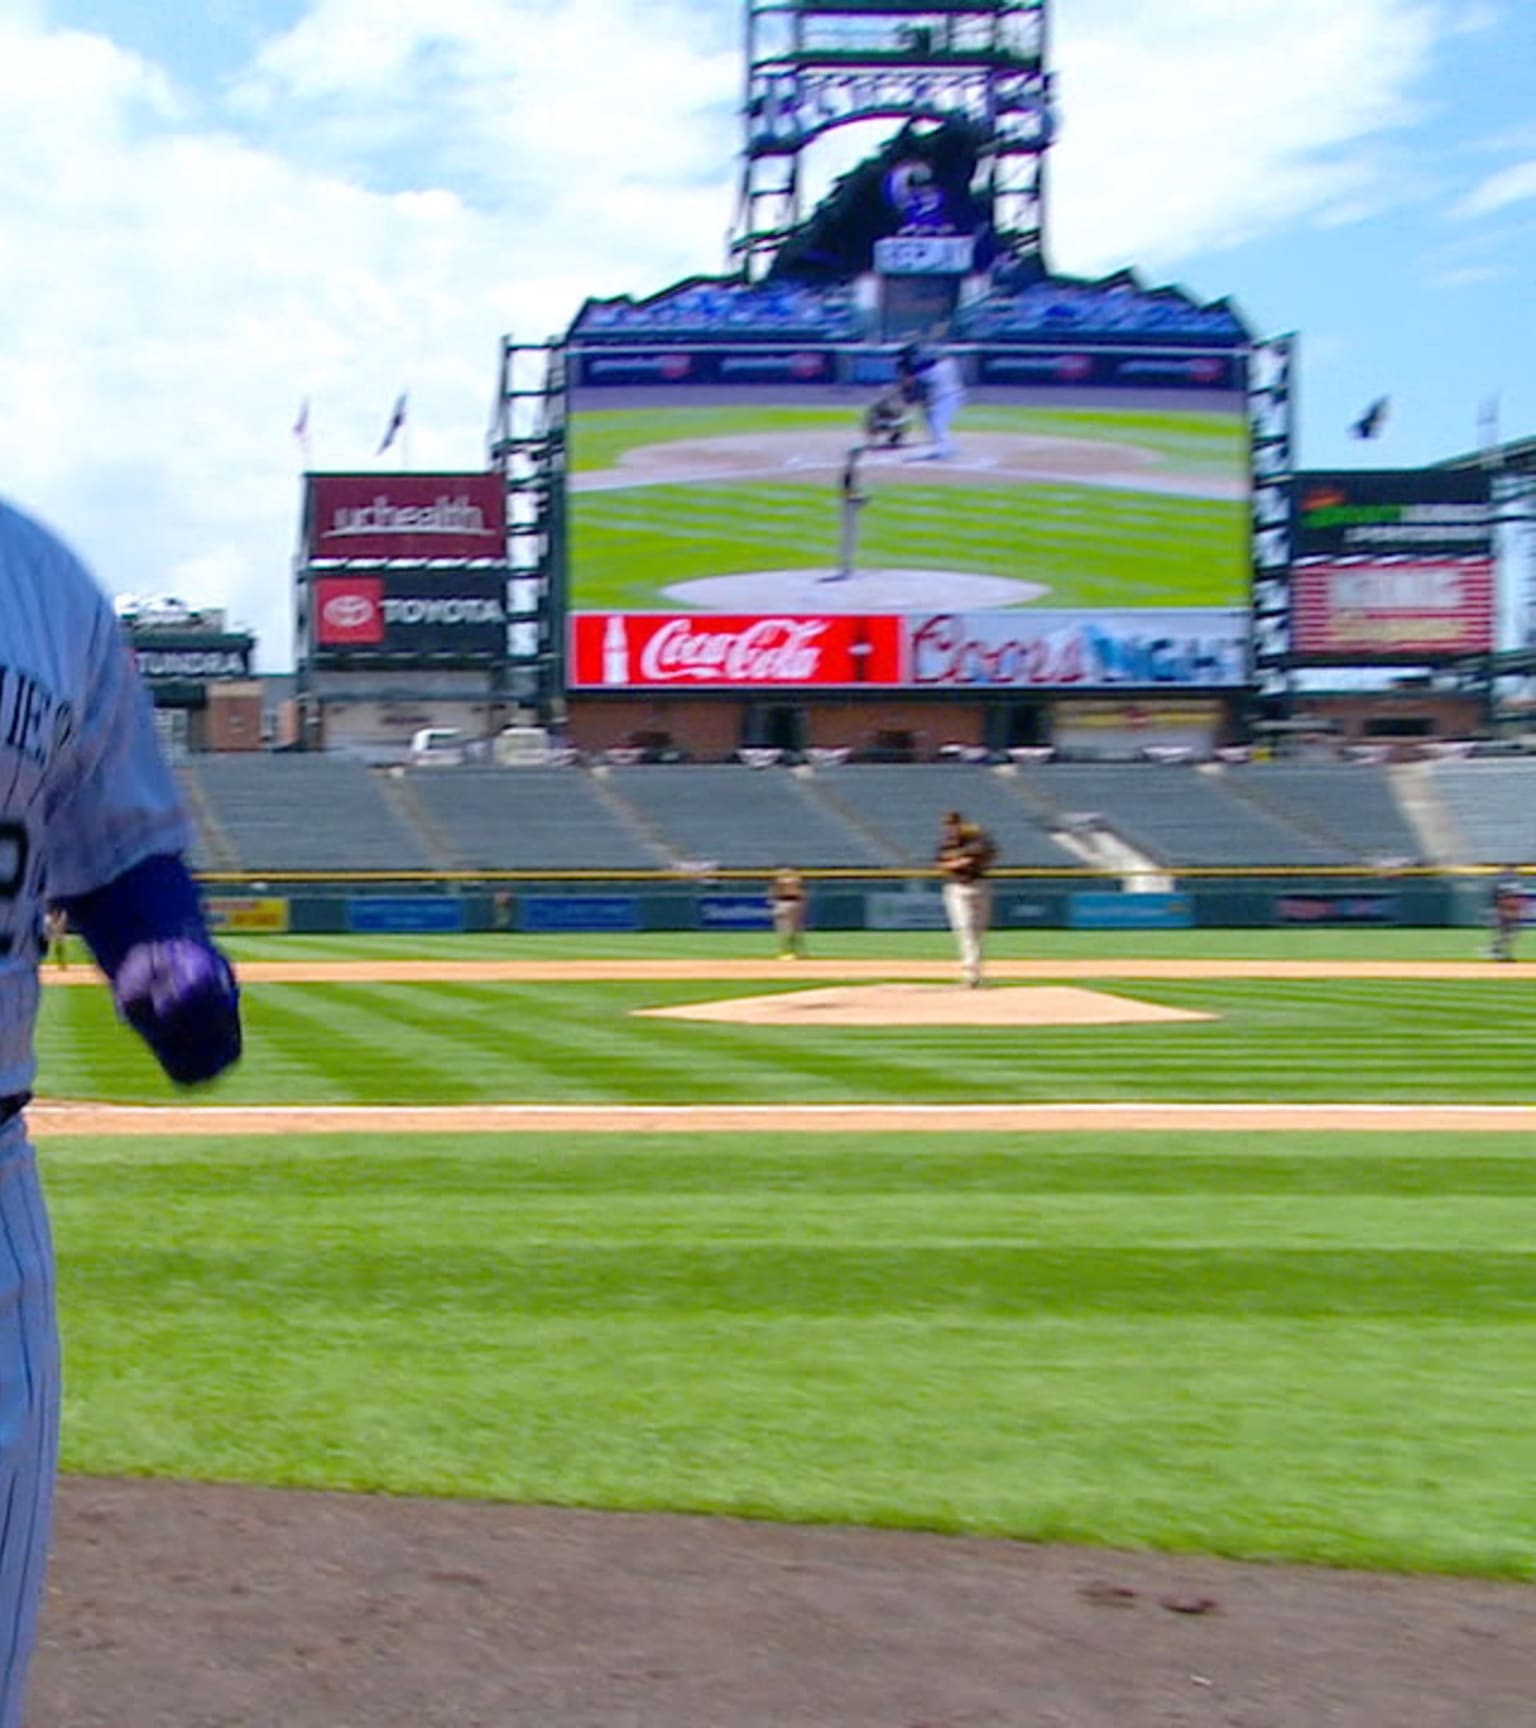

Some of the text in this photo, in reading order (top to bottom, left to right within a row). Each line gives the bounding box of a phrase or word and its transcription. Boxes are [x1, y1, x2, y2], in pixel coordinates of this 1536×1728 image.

[332, 494, 486, 529] uchealth
[378, 599, 505, 625] TOYOTA
[136, 651, 245, 675] TUNDRA
[640, 617, 832, 681] Coca-Cola
